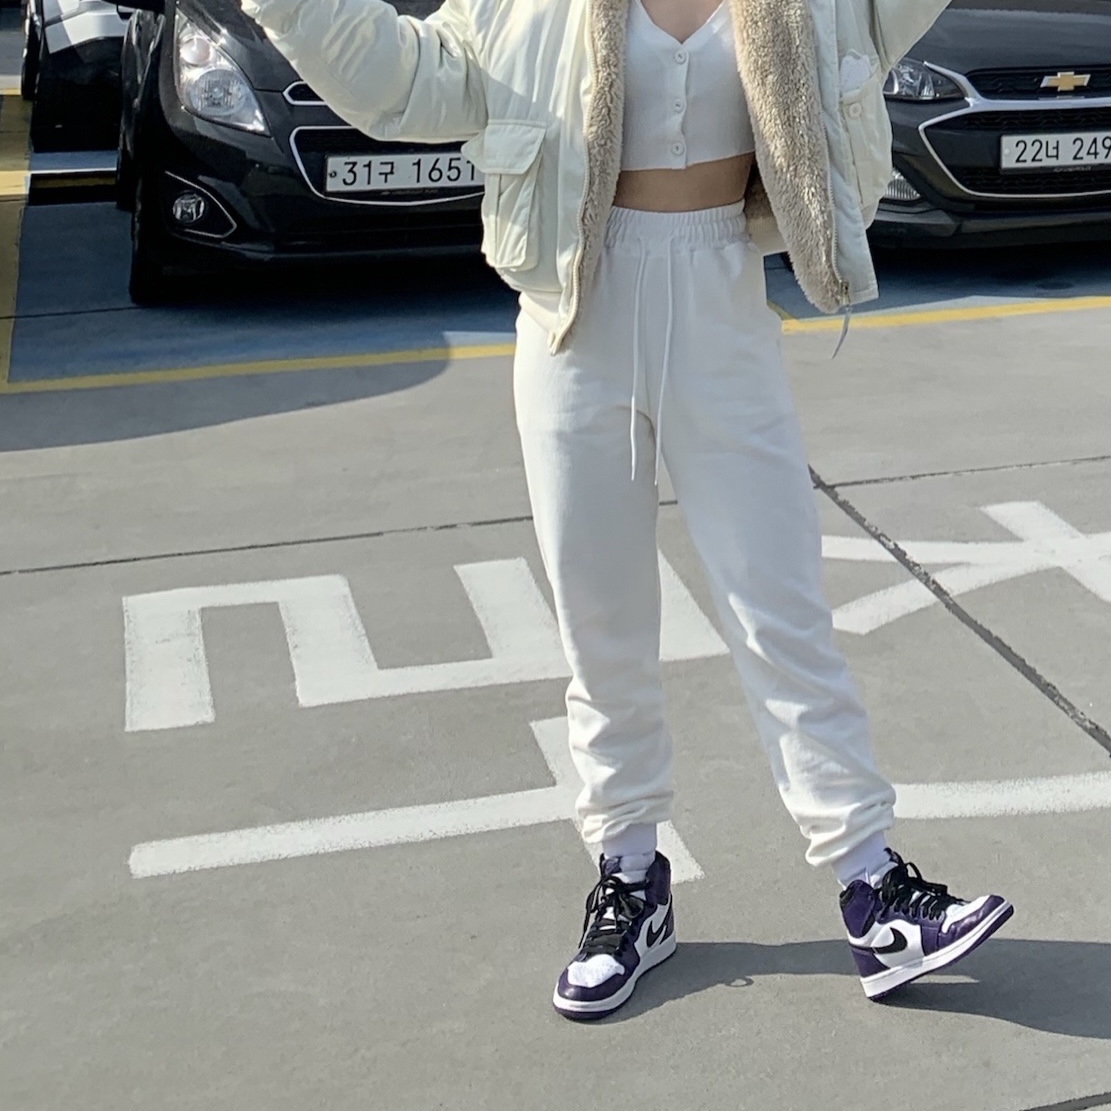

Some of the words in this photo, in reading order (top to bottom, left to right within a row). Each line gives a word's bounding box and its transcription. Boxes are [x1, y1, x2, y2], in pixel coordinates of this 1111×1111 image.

[1015, 139, 1060, 163] 22너
[342, 160, 395, 186] 31구
[412, 157, 475, 183] 1651
